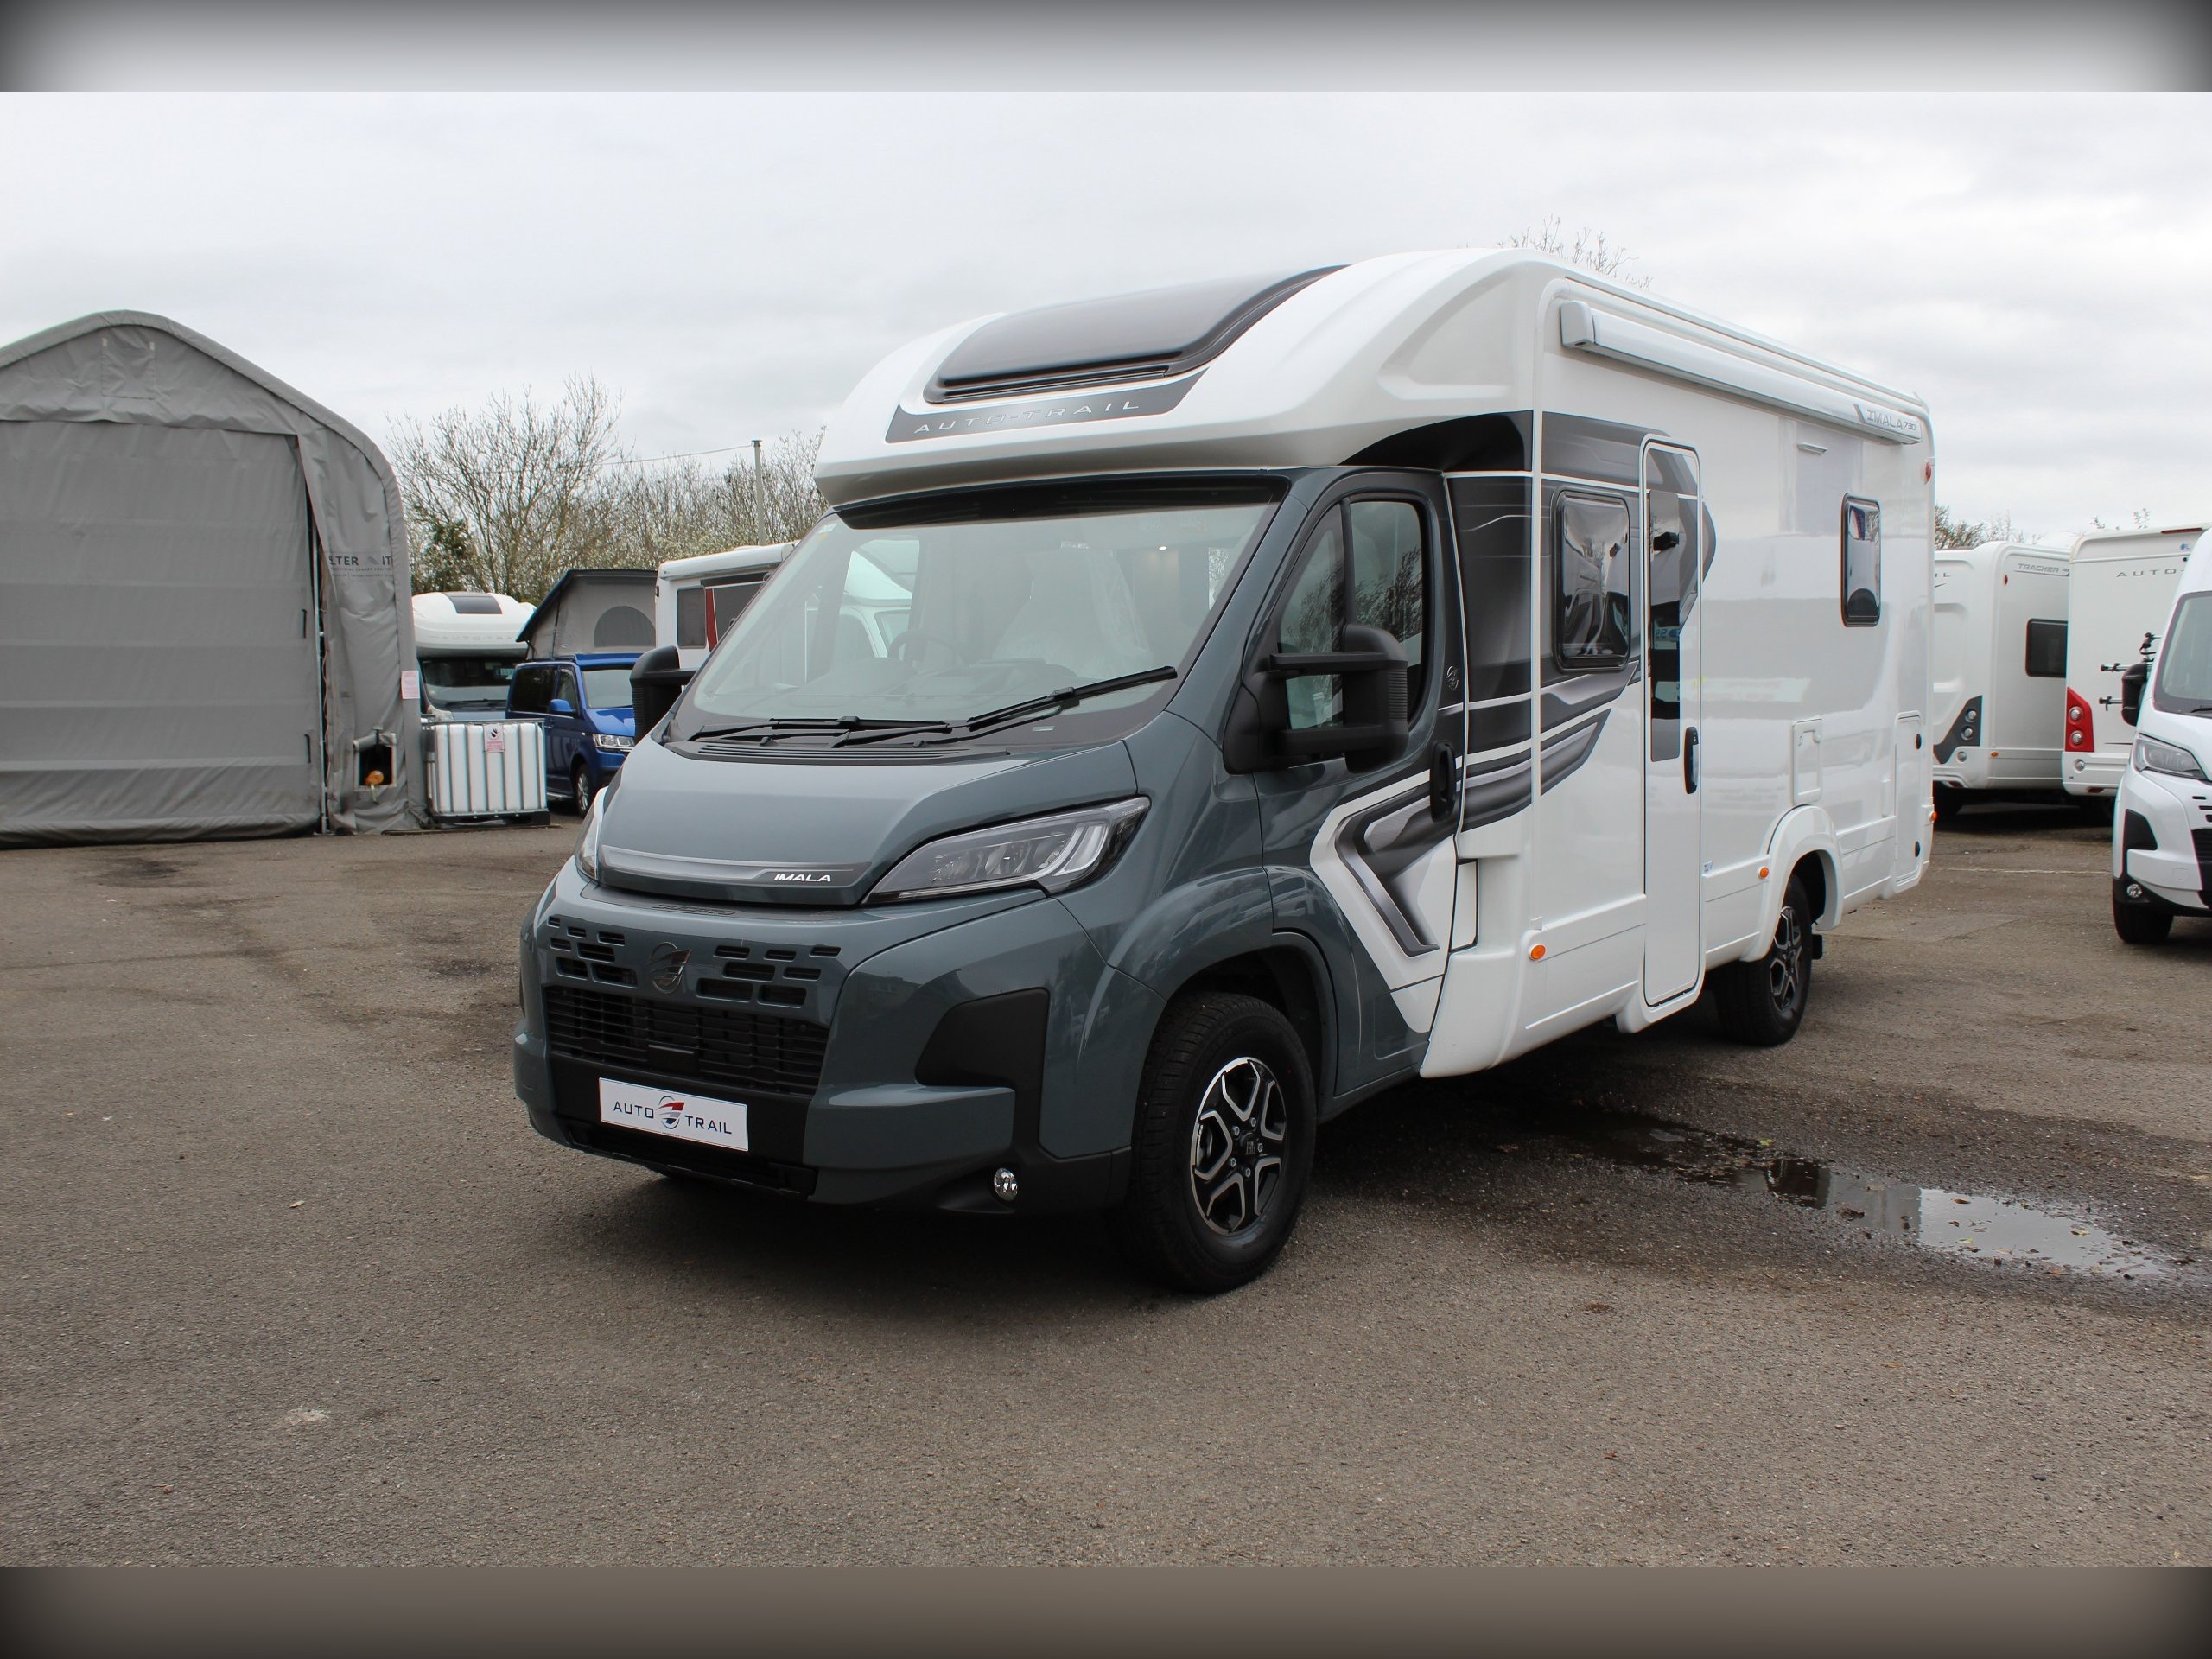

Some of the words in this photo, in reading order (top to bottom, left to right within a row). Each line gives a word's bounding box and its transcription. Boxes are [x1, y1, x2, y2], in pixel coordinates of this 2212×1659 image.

[1866, 409, 1903, 430] IMALA
[2018, 563, 2059, 573] TRACKER
[773, 874, 831, 882] IMALA
[613, 1101, 654, 1119] AUTO
[684, 1115, 733, 1135] TRAIL
